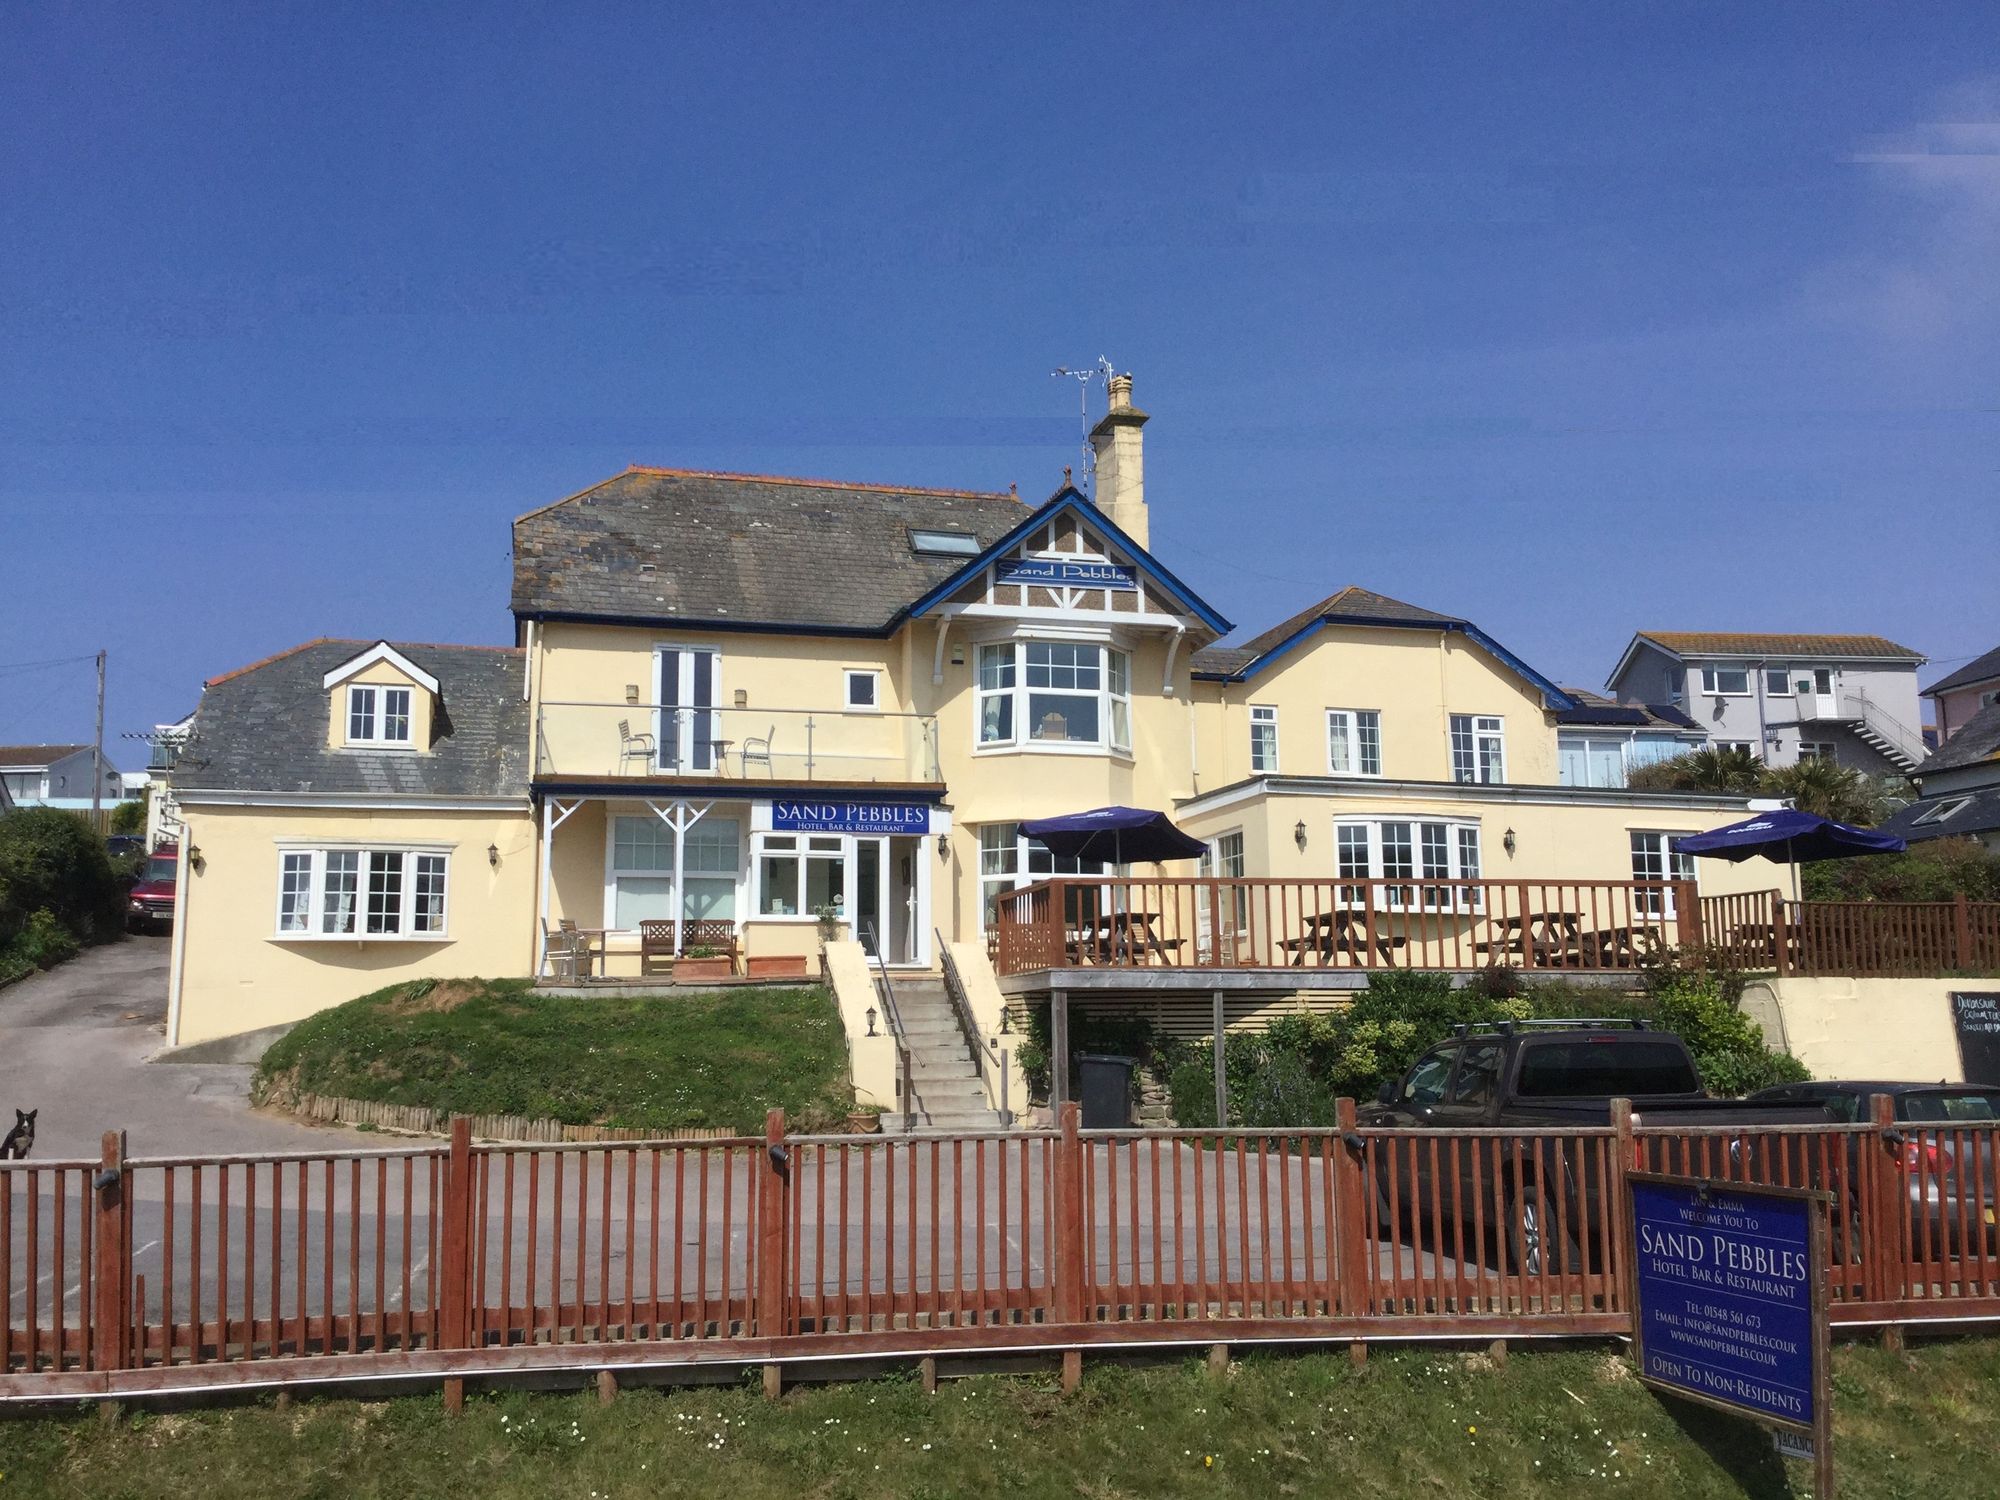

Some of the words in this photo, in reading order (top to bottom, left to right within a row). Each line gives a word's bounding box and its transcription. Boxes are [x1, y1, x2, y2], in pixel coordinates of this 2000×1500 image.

[998, 562, 1054, 577] Sand
[777, 801, 837, 820] SAND
[846, 803, 924, 823] PEBBLES
[828, 823, 844, 831] BAR
[845, 823, 853, 831] &
[855, 824, 905, 832] RESTAURANT
[1718, 1198, 1745, 1213] EMMA
[1679, 1208, 1722, 1225] WELCOME
[1724, 1215, 1743, 1228] YOU
[1744, 1217, 1759, 1230] TO
[1641, 1225, 1704, 1262] SAND
[1712, 1235, 1806, 1281] PEBBLES
[1653, 1258, 1689, 1279] HOTEL,
[1692, 1265, 1712, 1284] BAR
[1714, 1270, 1723, 1285] &
[1727, 1271, 1796, 1299] RESTAURANT
[1655, 1310, 1681, 1326] EMAIL:
[1685, 1300, 1702, 1315] TEL:
[1704, 1305, 1728, 1321] 01548
[1730, 1310, 1743, 1324] 561
[1746, 1314, 1761, 1328] 673
[1652, 1356, 1682, 1378] OPEN
[1685, 1364, 1701, 1383] TO
[1704, 1371, 1802, 1413] NON-RESIDENTS
